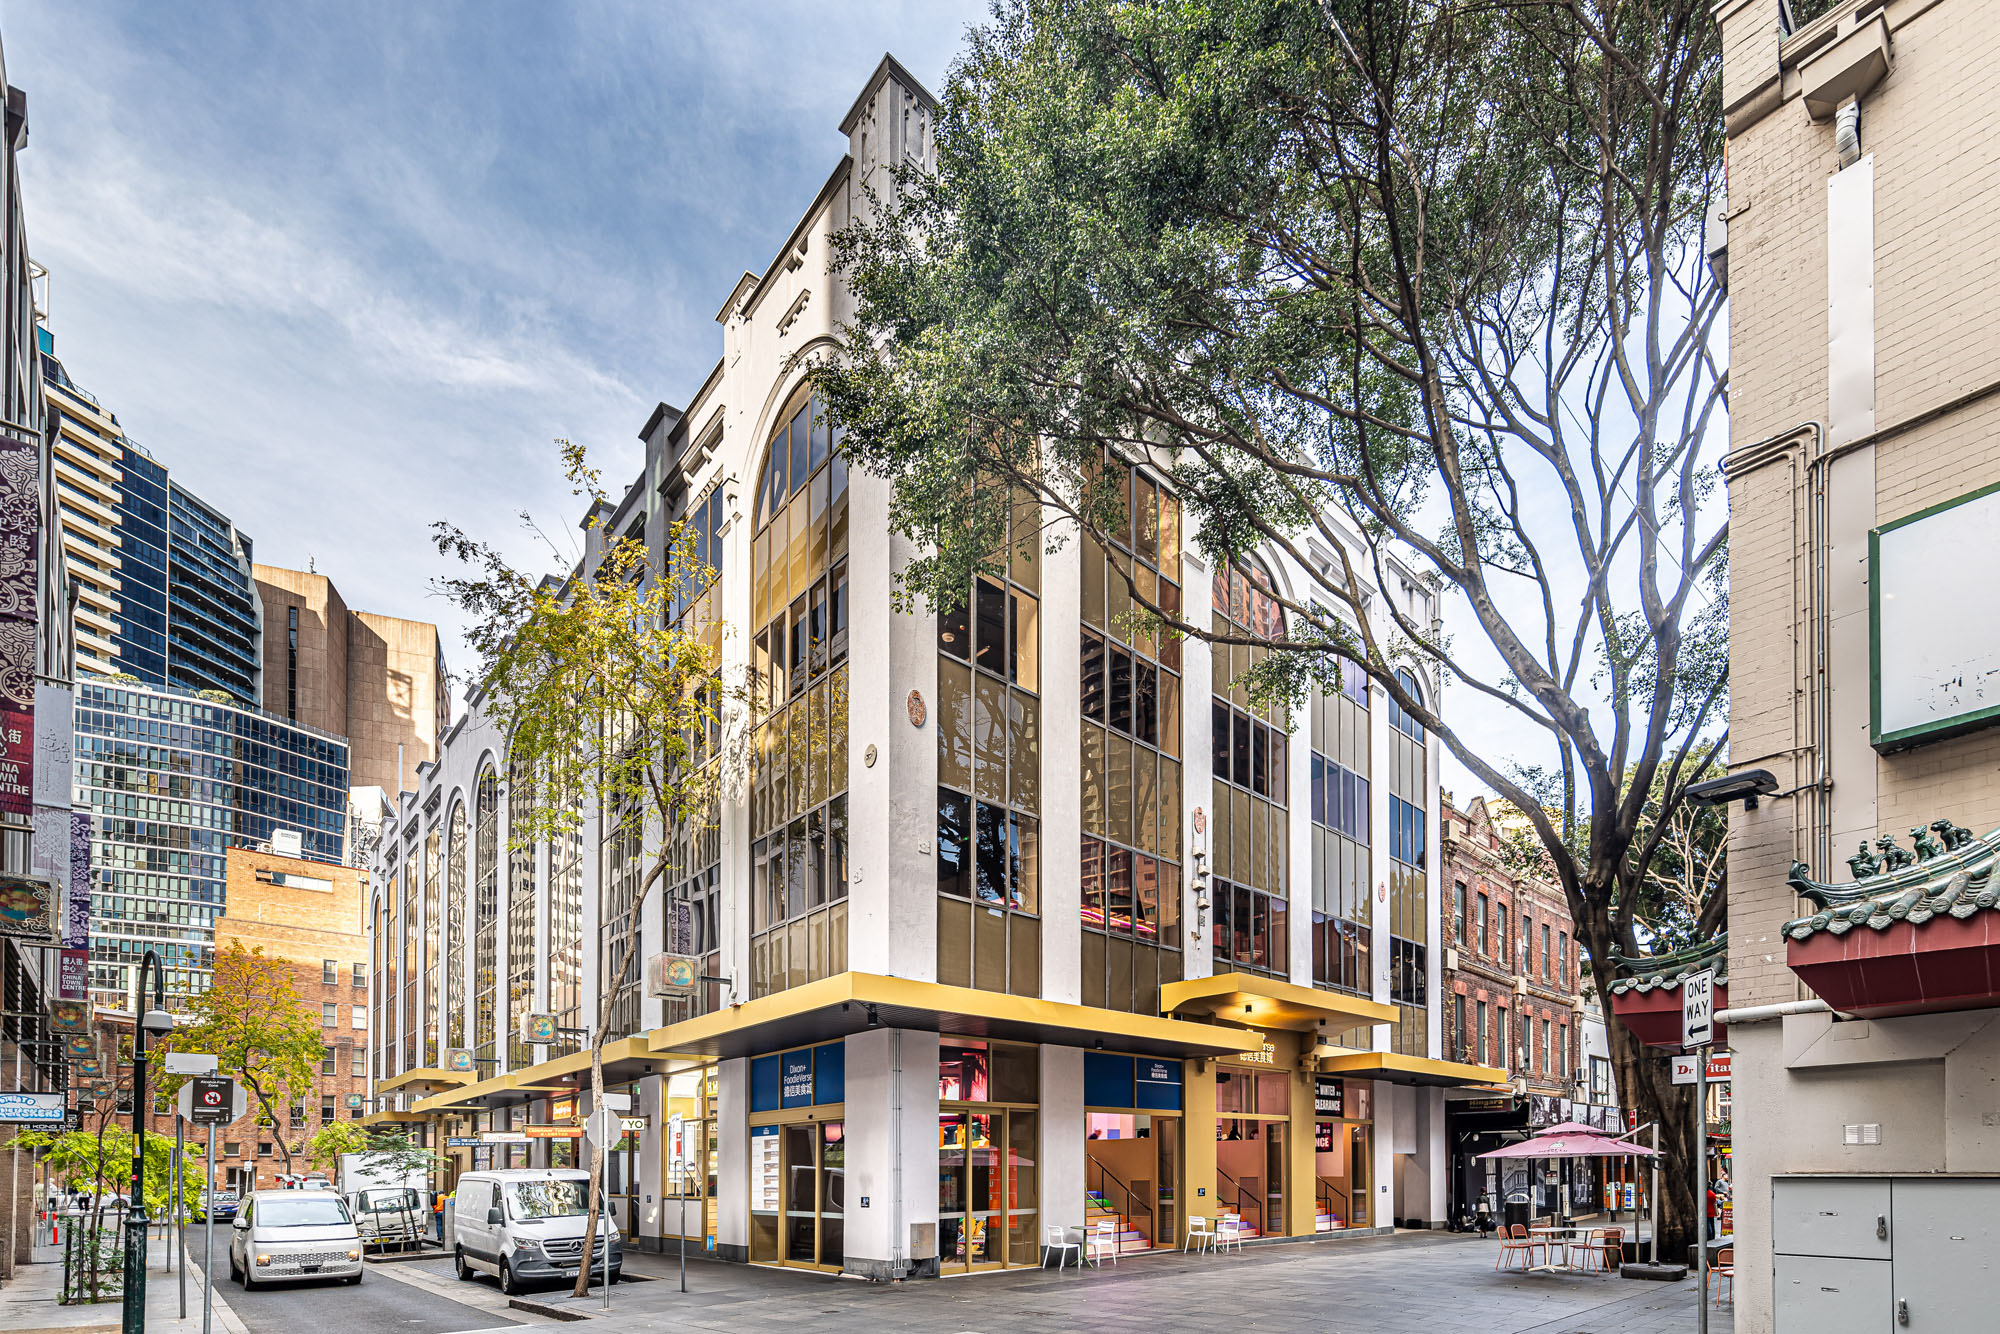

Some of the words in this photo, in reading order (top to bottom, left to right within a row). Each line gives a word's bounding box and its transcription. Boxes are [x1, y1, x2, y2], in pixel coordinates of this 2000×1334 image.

[62, 957, 84, 966] 唐人街
[1688, 977, 1708, 998] ONE
[1686, 999, 1709, 1021] WAY
[789, 1064, 807, 1074] Dixon+
[1677, 1065, 1694, 1075] Dr
[783, 1073, 812, 1085] FoodieVerse
[1320, 1084, 1335, 1096] WINTER
[1315, 1099, 1340, 1111] CLEARANCE
